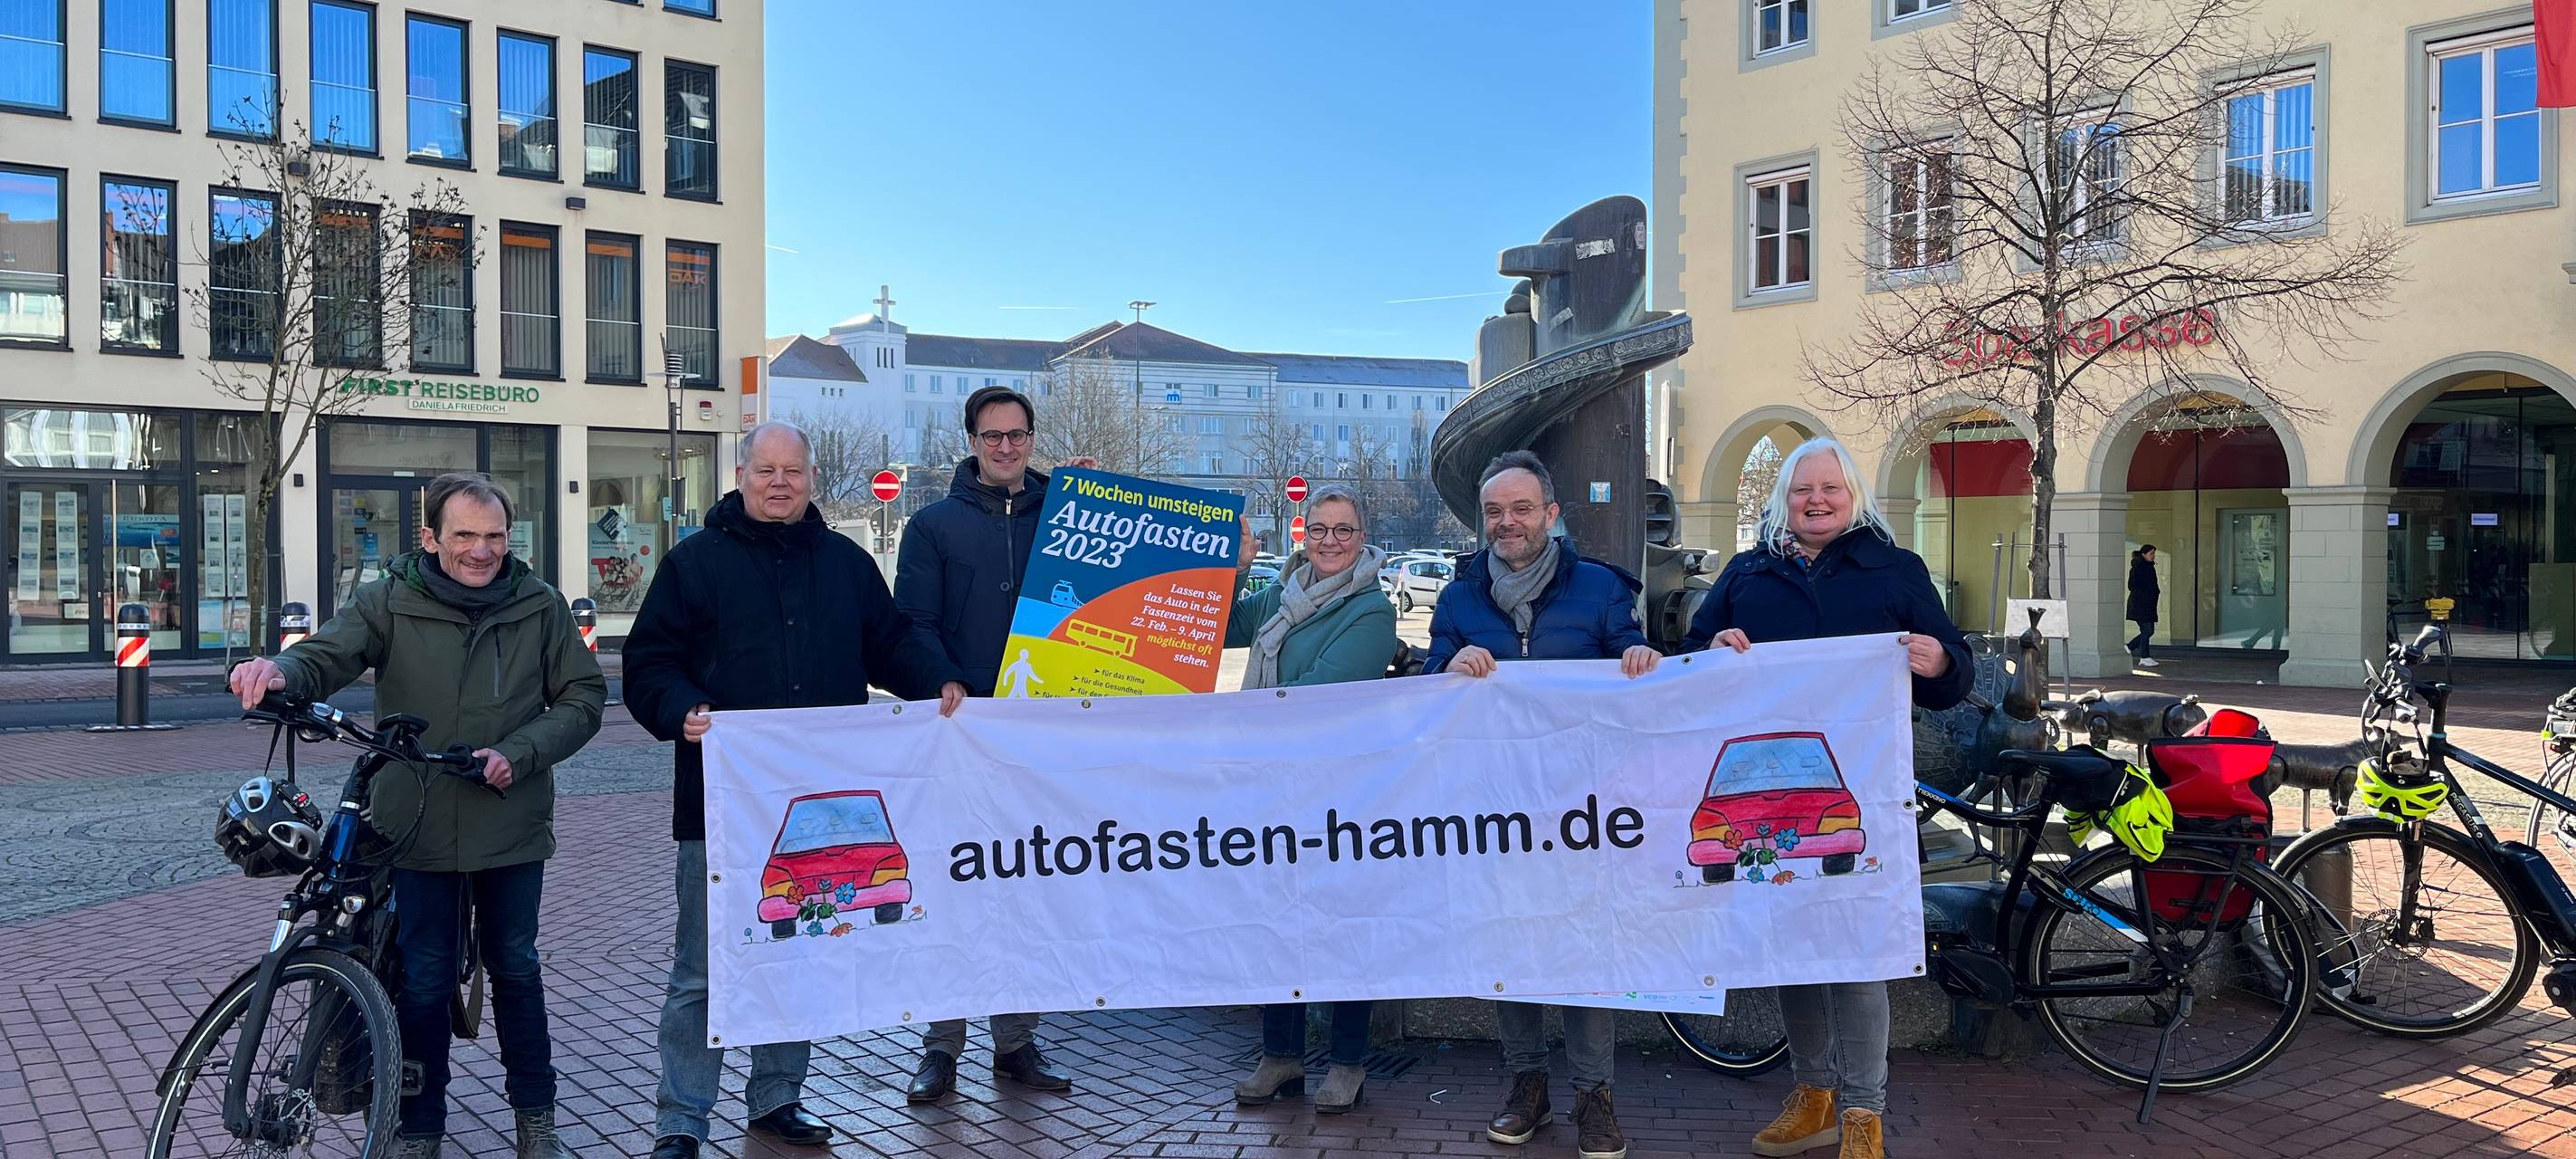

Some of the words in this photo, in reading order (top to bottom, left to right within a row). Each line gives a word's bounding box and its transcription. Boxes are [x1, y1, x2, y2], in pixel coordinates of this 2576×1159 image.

[670, 268, 706, 284] DAK
[1942, 306, 2215, 367] Spakasse
[420, 381, 539, 403] REISEBÜRO
[412, 399, 454, 410] DANIELA
[455, 403, 506, 413] FRIEDRICH
[1062, 475, 1073, 492] 7
[1078, 478, 1143, 506] Wochen
[1148, 494, 1234, 523] umsteigen
[1048, 500, 1231, 559] Autofasten
[1041, 529, 1128, 569] 2023
[1143, 591, 1163, 604] das
[1164, 596, 1188, 608] Auto
[1189, 600, 1200, 611] in
[1202, 603, 1220, 615] der
[1170, 583, 1205, 599] Lassen
[1206, 590, 1222, 602] Sie
[1141, 605, 1195, 623] Fastenzeit
[1197, 617, 1217, 628] vom
[1131, 616, 1145, 627] 22.
[1148, 619, 1169, 632] Feb.
[1178, 626, 1187, 636] 9.
[1188, 628, 1216, 642] April
[1146, 634, 1197, 652] möglichst
[1197, 644, 1213, 656] oft
[1173, 653, 1209, 668] stehen.
[1081, 676, 1092, 685] für
[1093, 678, 1104, 688] die
[1104, 682, 1143, 696] Gesundheit
[1102, 669, 1112, 677] für
[1126, 675, 1145, 685] Klima
[1077, 687, 1088, 695] für
[2449, 791, 2480, 833] PEGASUS
[949, 794, 1646, 883] autofasten-hamm.de
